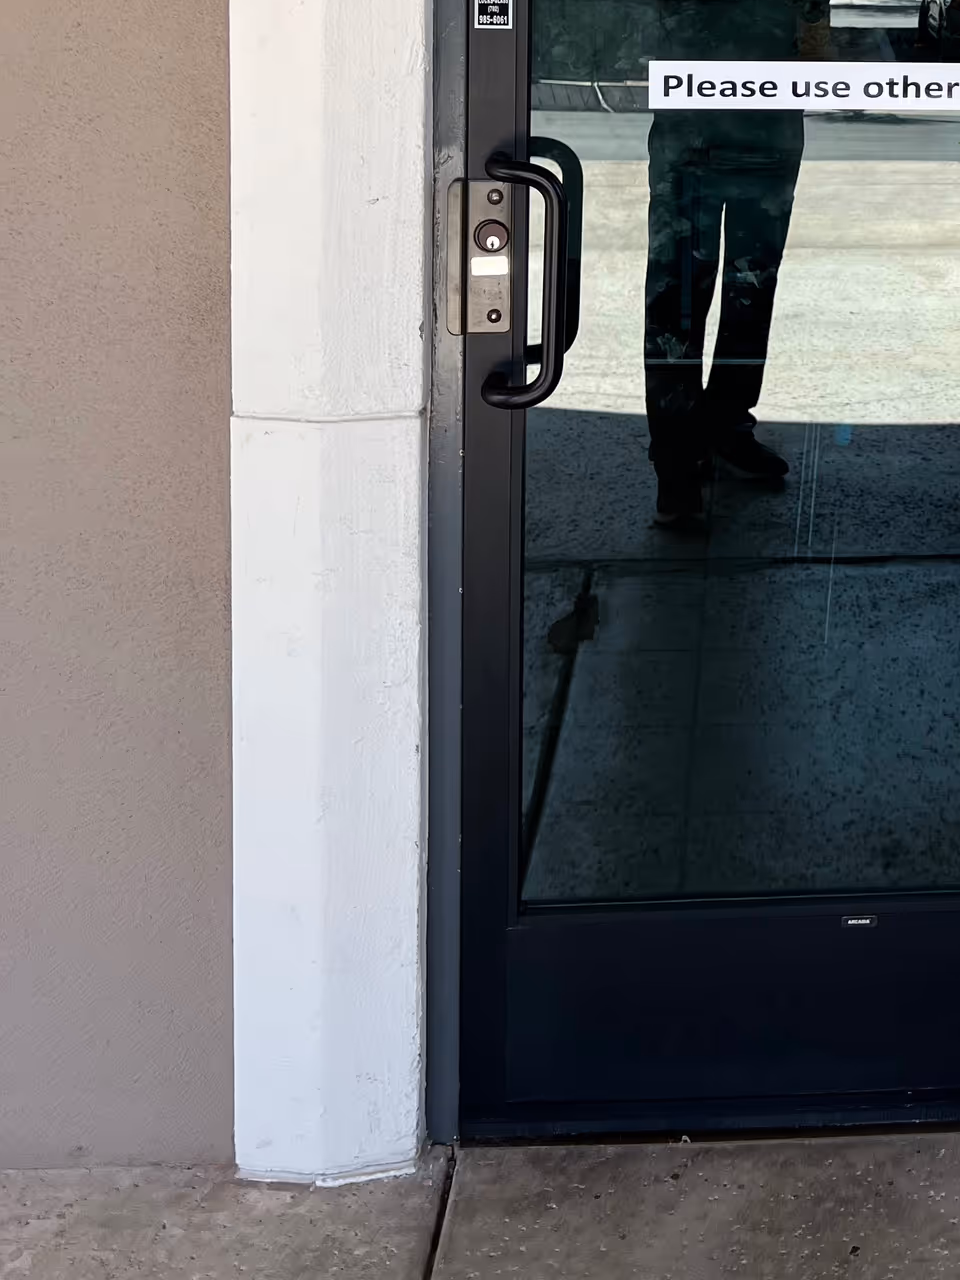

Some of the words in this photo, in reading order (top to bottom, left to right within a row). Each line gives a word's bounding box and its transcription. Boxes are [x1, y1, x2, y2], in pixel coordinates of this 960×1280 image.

[663, 73, 778, 98] Please
[791, 79, 851, 98] use
[863, 75, 960, 99] other
